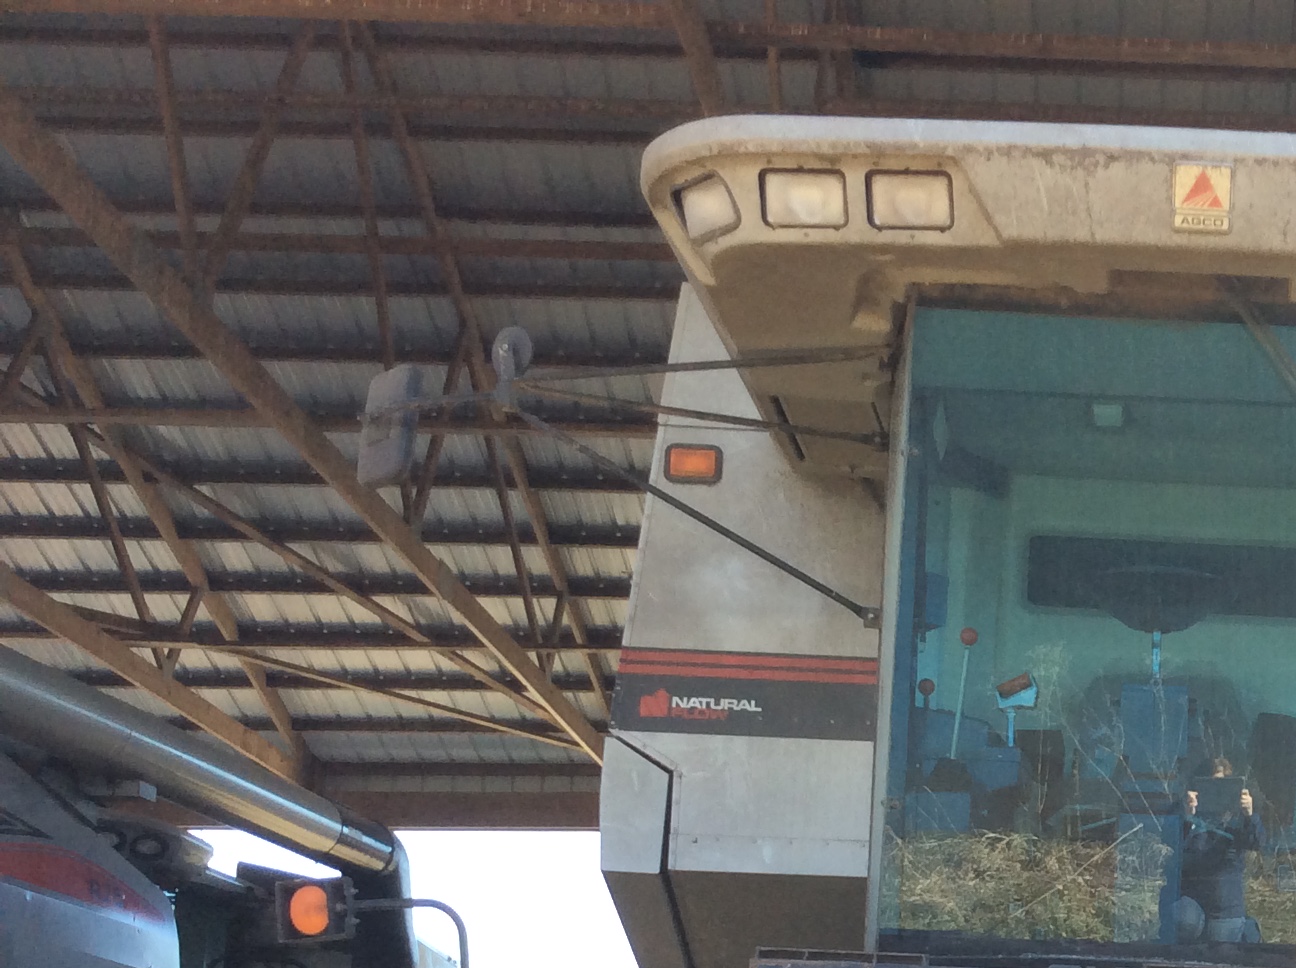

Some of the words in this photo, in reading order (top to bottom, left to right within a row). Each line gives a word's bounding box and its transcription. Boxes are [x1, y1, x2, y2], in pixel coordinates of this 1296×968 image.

[1180, 216, 1224, 226] AGCO
[672, 696, 762, 712] NATURAL
[671, 708, 729, 720] FLOW
